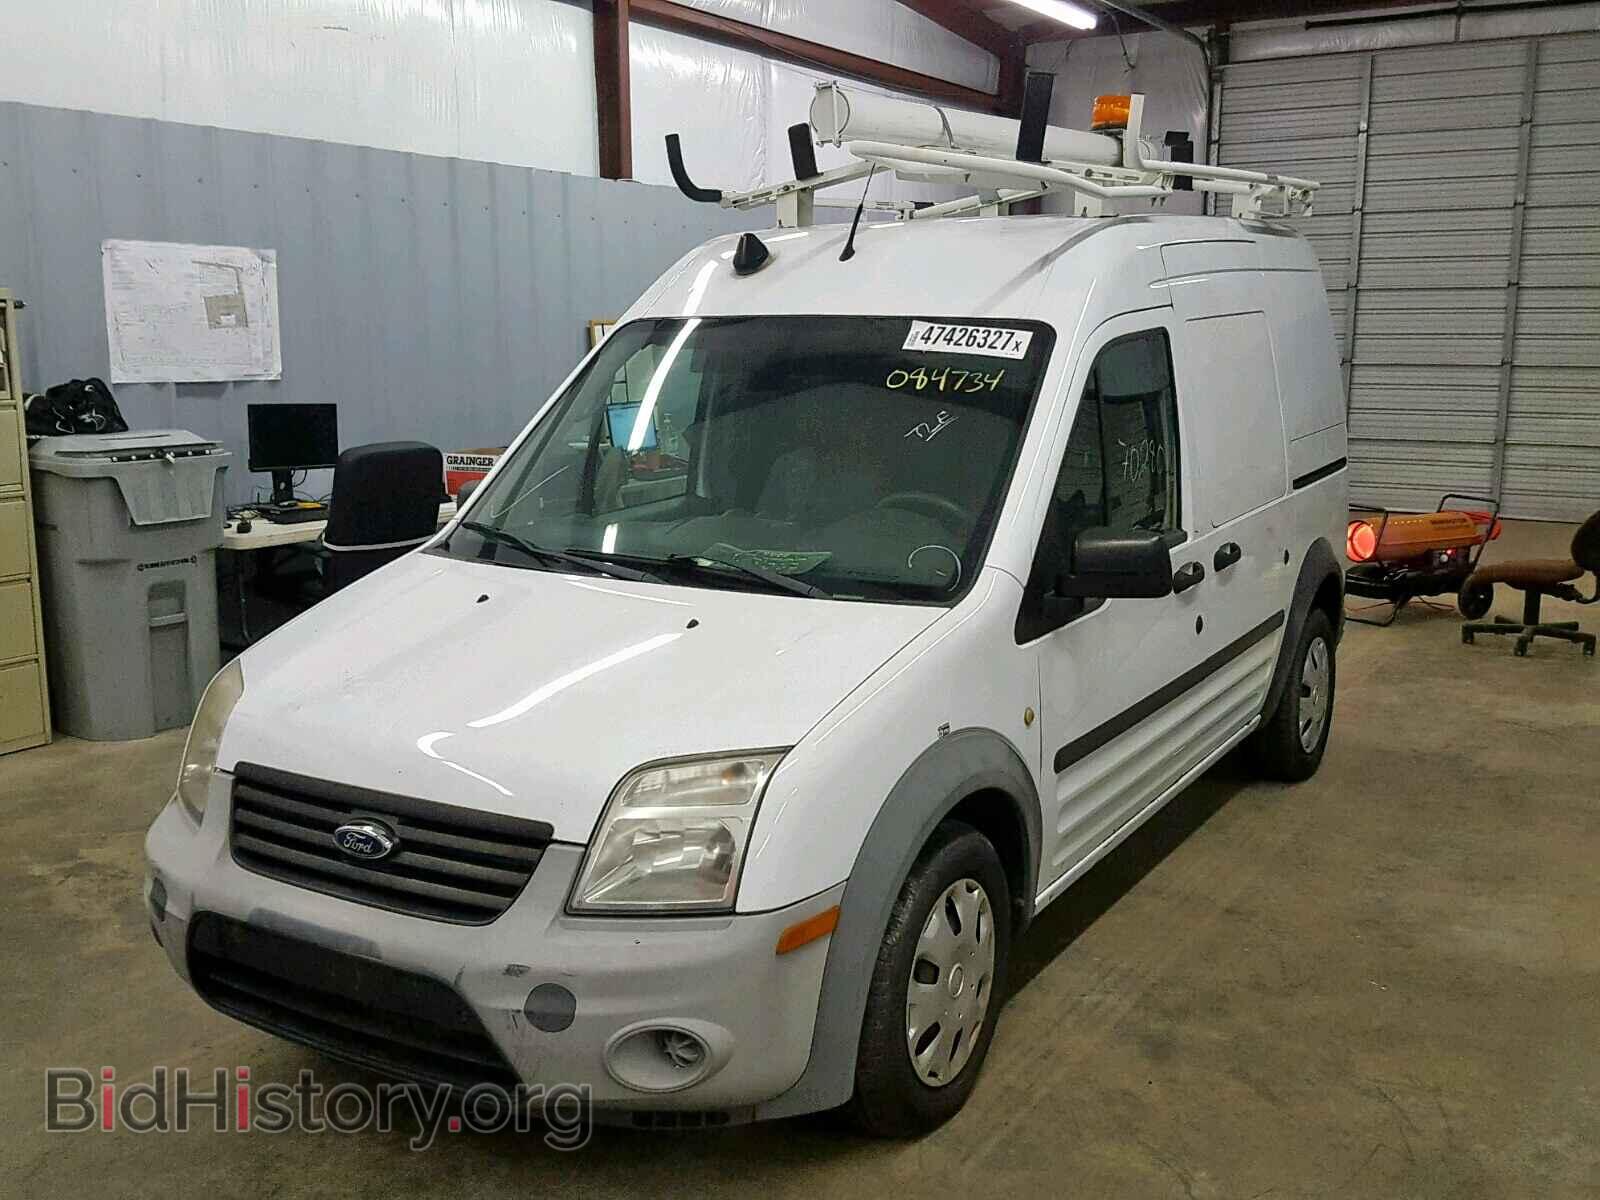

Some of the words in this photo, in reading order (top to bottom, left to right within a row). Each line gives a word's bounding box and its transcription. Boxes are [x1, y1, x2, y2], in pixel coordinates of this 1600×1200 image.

[886, 368, 1005, 393] 084734
[446, 455, 494, 466] GRAINGER
[343, 832, 374, 853] Ford
